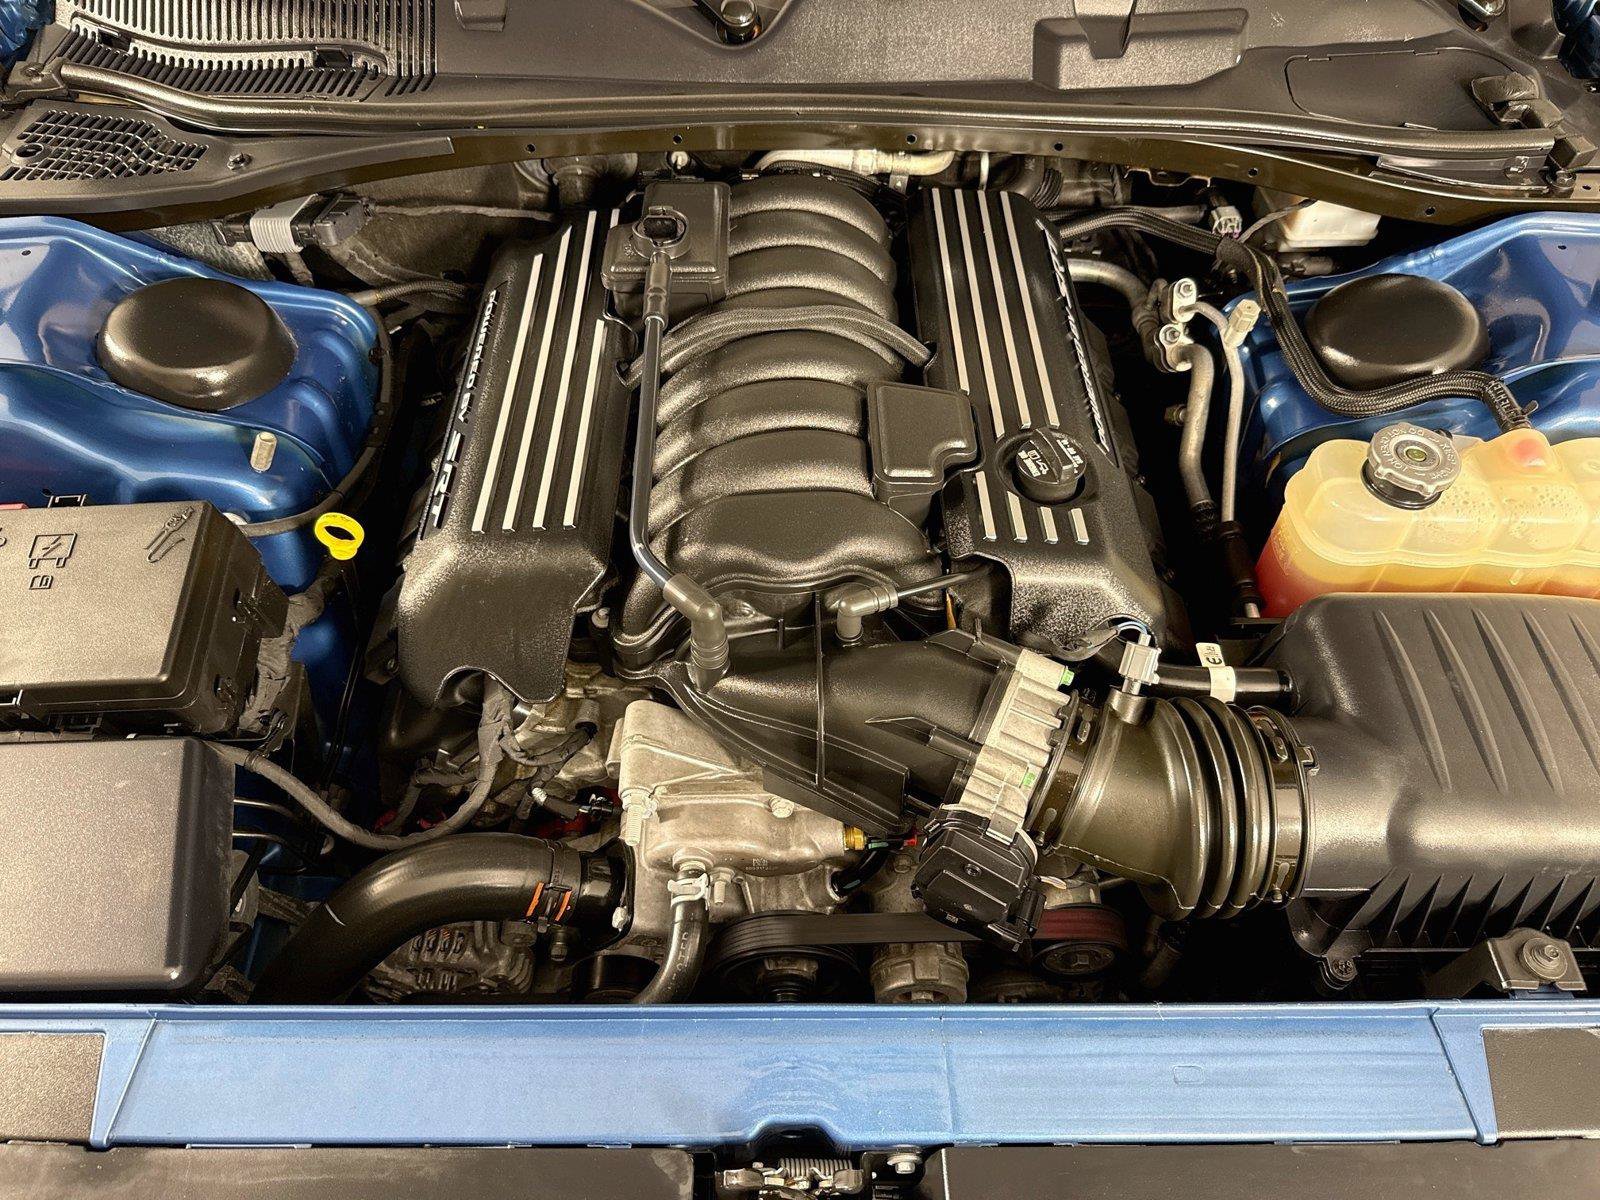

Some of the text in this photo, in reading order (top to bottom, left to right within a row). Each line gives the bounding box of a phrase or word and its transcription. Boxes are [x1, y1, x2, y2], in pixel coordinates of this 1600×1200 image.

[430, 289, 497, 528] POWERED BY SRT
